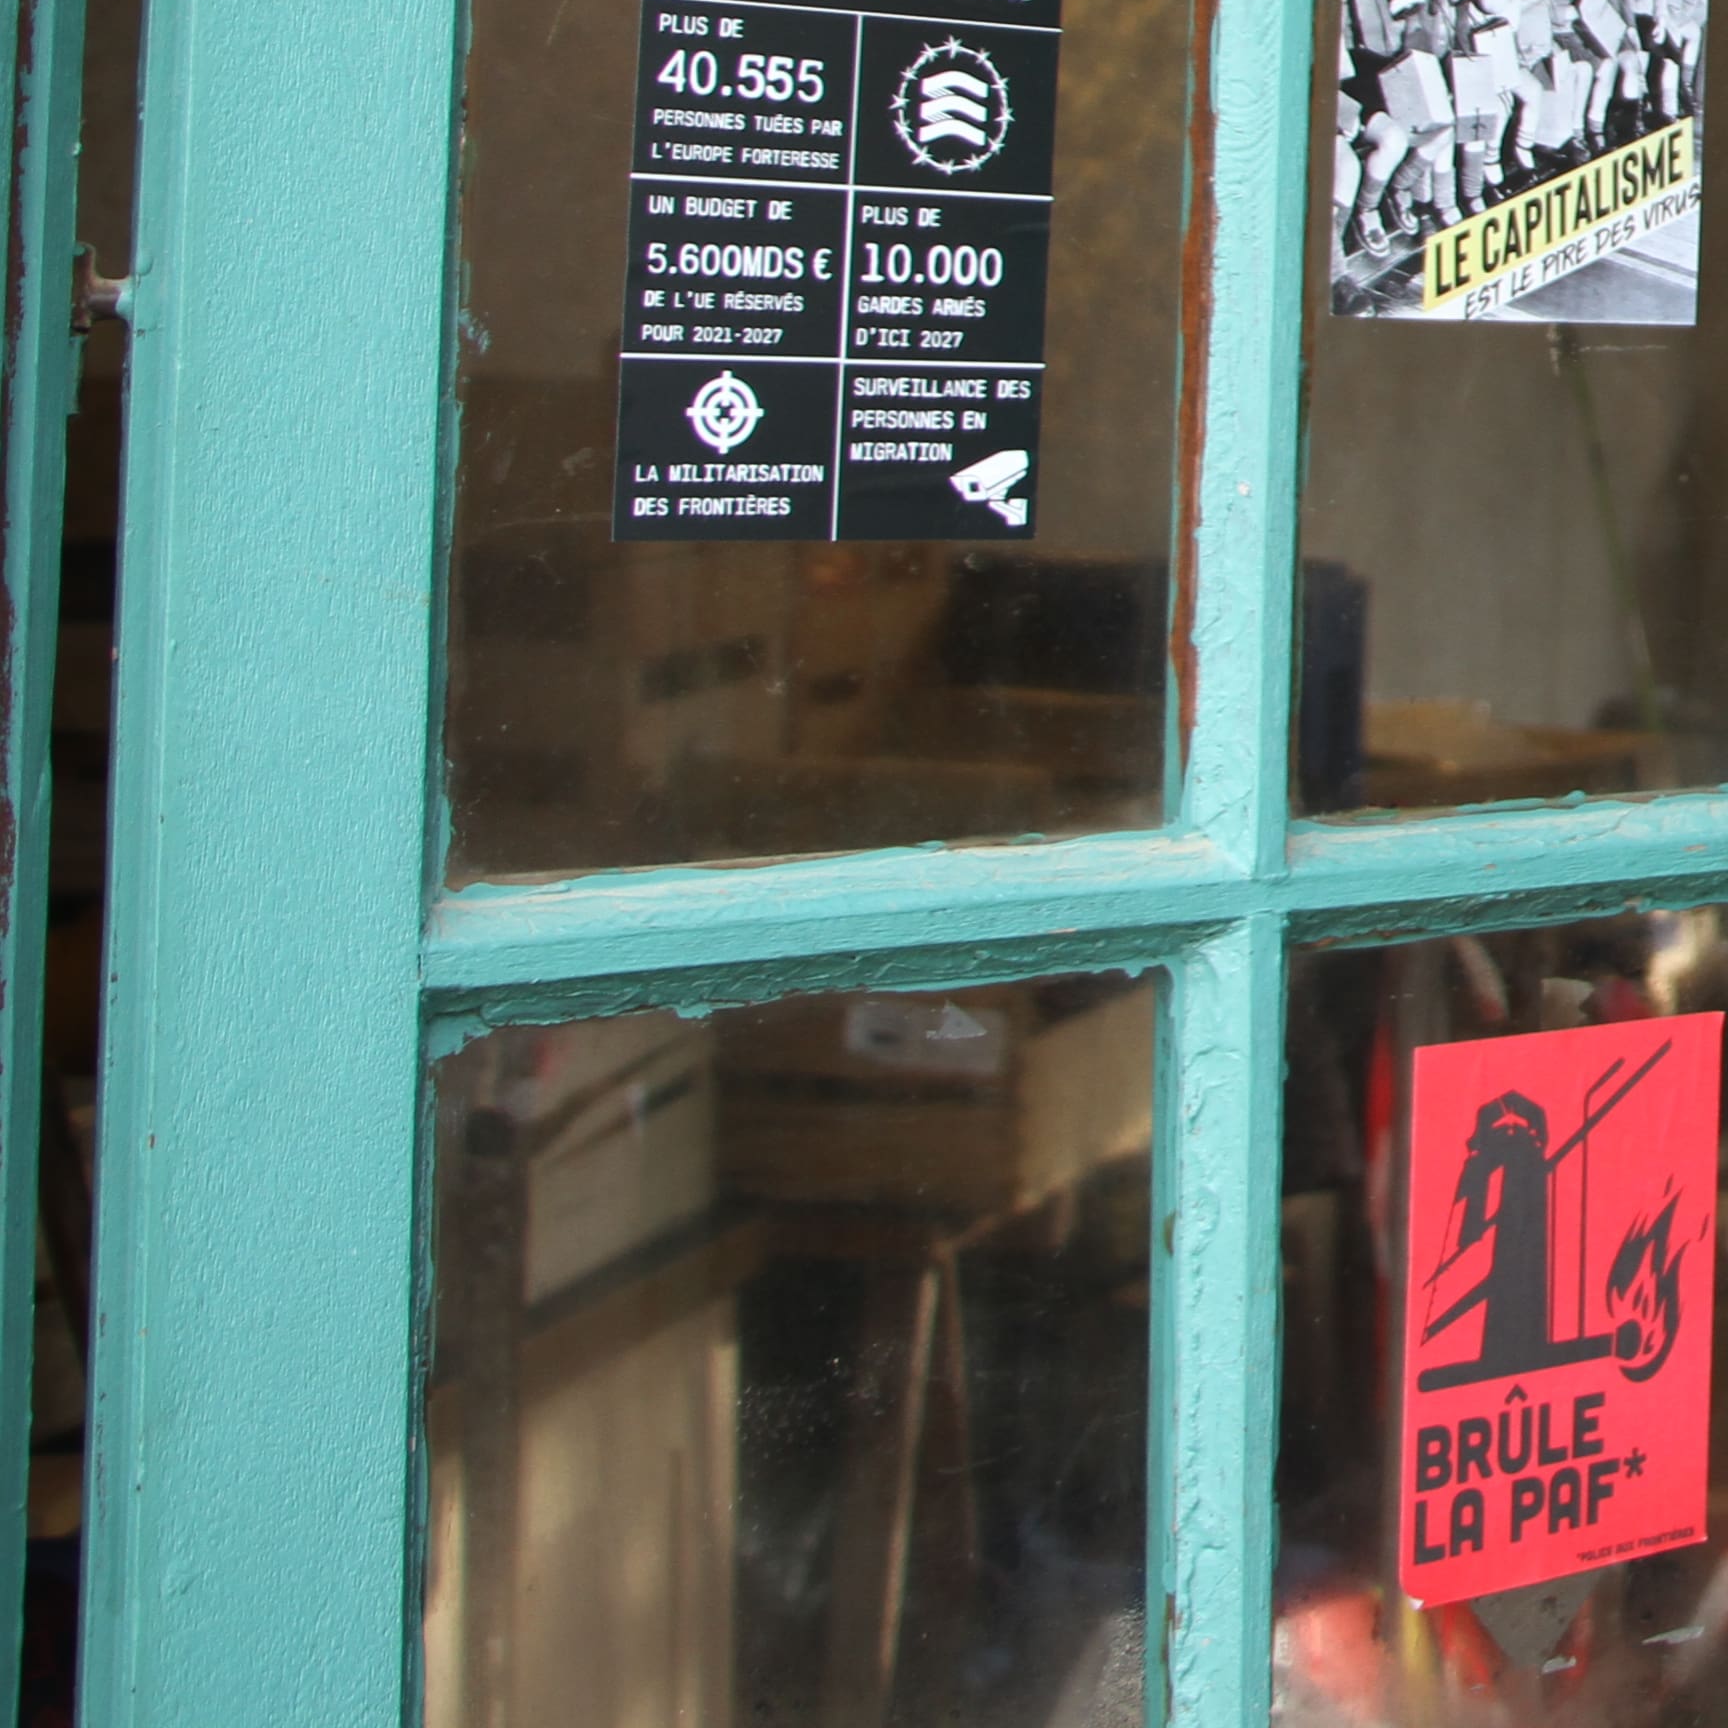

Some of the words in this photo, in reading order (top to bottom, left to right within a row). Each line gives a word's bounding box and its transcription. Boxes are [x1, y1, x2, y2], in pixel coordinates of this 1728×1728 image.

[659, 13, 708, 36] PLUS
[719, 17, 744, 38] DE
[657, 49, 825, 103] 40.555
[653, 109, 745, 131] PERSONNES
[755, 113, 804, 135] TUÉES
[812, 119, 842, 137] PAR
[651, 142, 733, 163] L'EUROPE
[742, 147, 840, 170] FORTERESSE
[649, 195, 675, 215] UN
[685, 197, 757, 218] BUDGET
[768, 200, 792, 220] DE
[861, 205, 908, 226] PLUS
[918, 208, 941, 227] DE
[1433, 236, 1471, 298] LE
[1480, 129, 1685, 273] CAPITALISME
[647, 243, 805, 279] 5.600MDS
[812, 248, 833, 281] €
[1464, 289, 1503, 320] EST
[1510, 268, 1534, 296] LE
[1540, 239, 1588, 278] PIRE
[1593, 221, 1635, 250] DES
[1641, 182, 1700, 232] VIRUS
[860, 243, 1002, 287] 10.000
[643, 290, 665, 308] DE
[674, 291, 714, 309] L'UE
[724, 291, 804, 313] RÉSERVÉS
[857, 295, 923, 315] GARDES
[932, 295, 986, 317] ARMÉS
[641, 325, 684, 342] POUR
[693, 326, 782, 344] 2021-2027
[856, 328, 911, 347] D'ICI
[920, 331, 963, 348] 2027
[853, 378, 987, 399] SURVEILLANCE
[997, 379, 1030, 399] DES
[851, 410, 954, 430] PERSONNES
[963, 412, 986, 430] EN
[850, 443, 952, 462] MIGRATION
[635, 464, 658, 482] LA
[669, 464, 823, 483] MILITARISATION
[634, 498, 668, 516] DES
[679, 495, 791, 516] FRONTIÈRES
[1415, 1385, 1605, 1494] BRÛLE
[1414, 1488, 1485, 1566] LA
